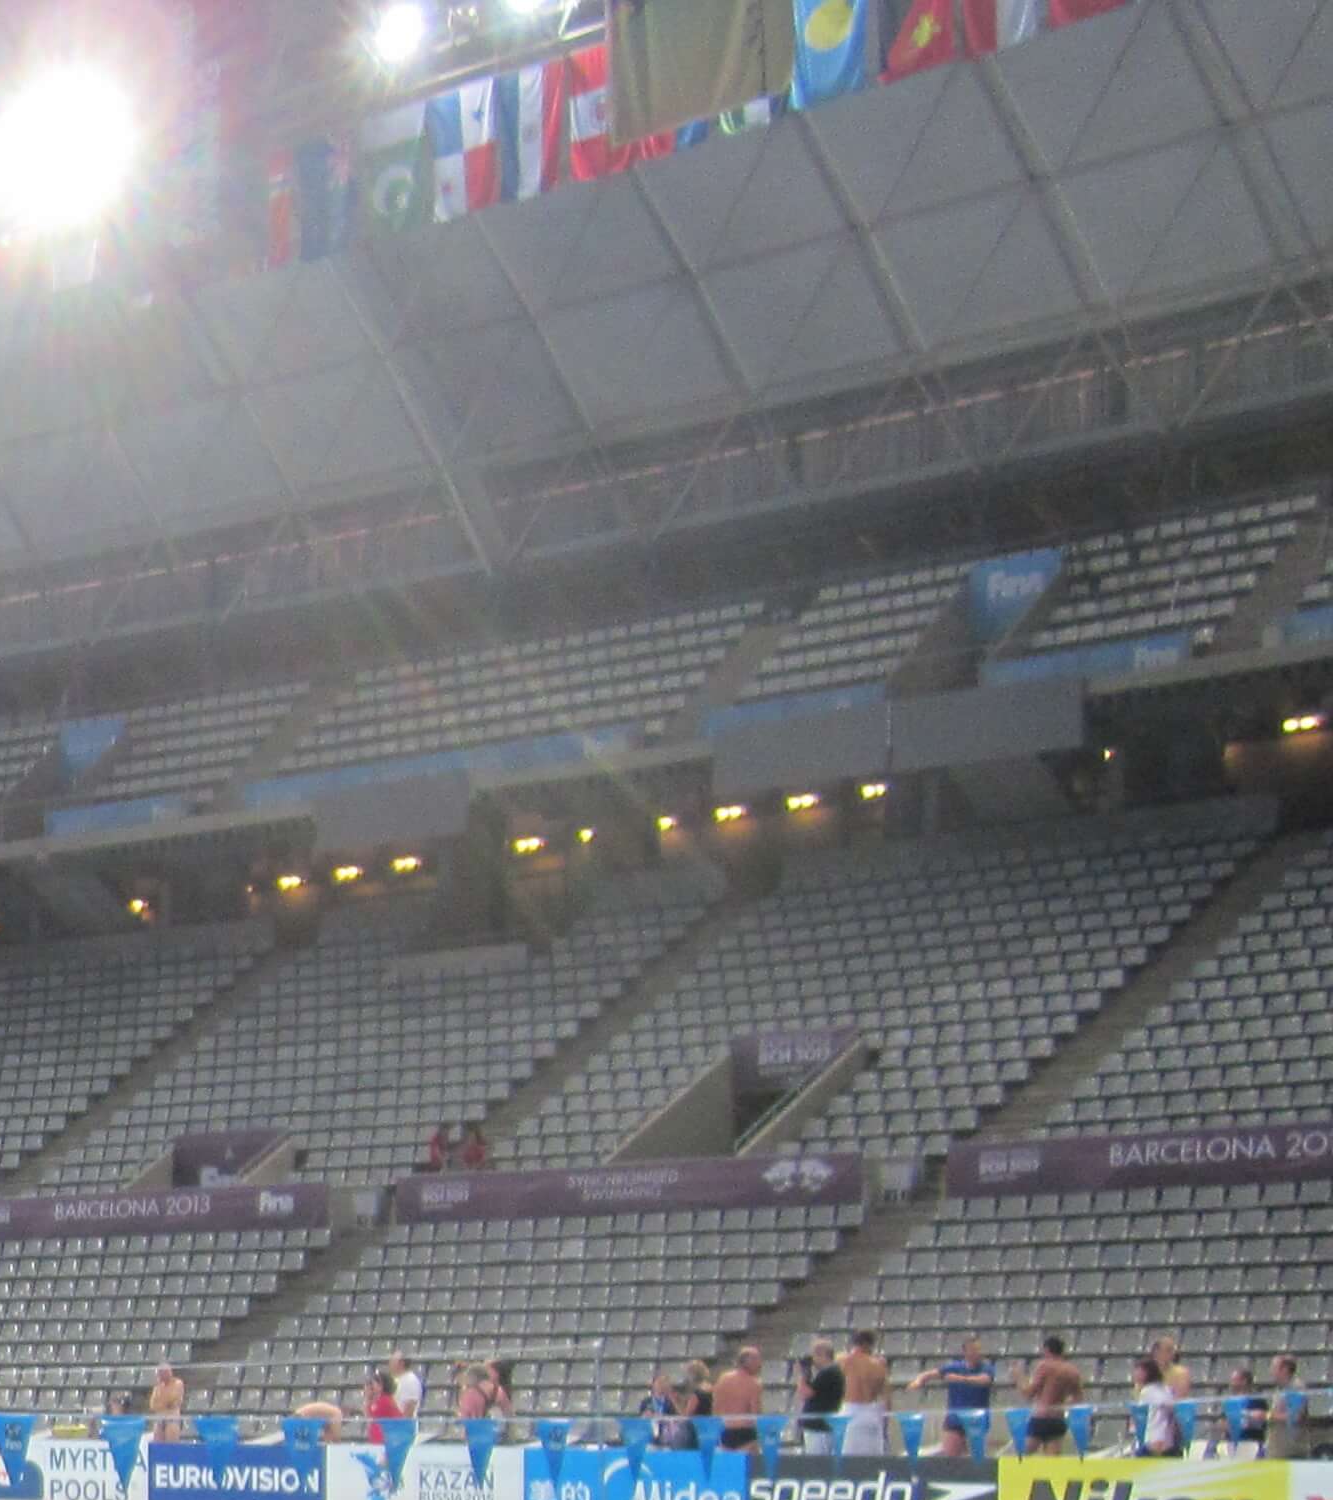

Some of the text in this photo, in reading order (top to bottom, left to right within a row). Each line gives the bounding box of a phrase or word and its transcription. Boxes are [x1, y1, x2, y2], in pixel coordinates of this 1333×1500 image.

[1109, 1131, 1333, 1166] BARCELONA 20
[53, 1199, 160, 1221] BARCELONA
[166, 1197, 211, 1217] 2013
[50, 1447, 147, 1471] MYRTA
[50, 1480, 128, 1500] POOLS
[418, 1469, 494, 1491] KAZAN
